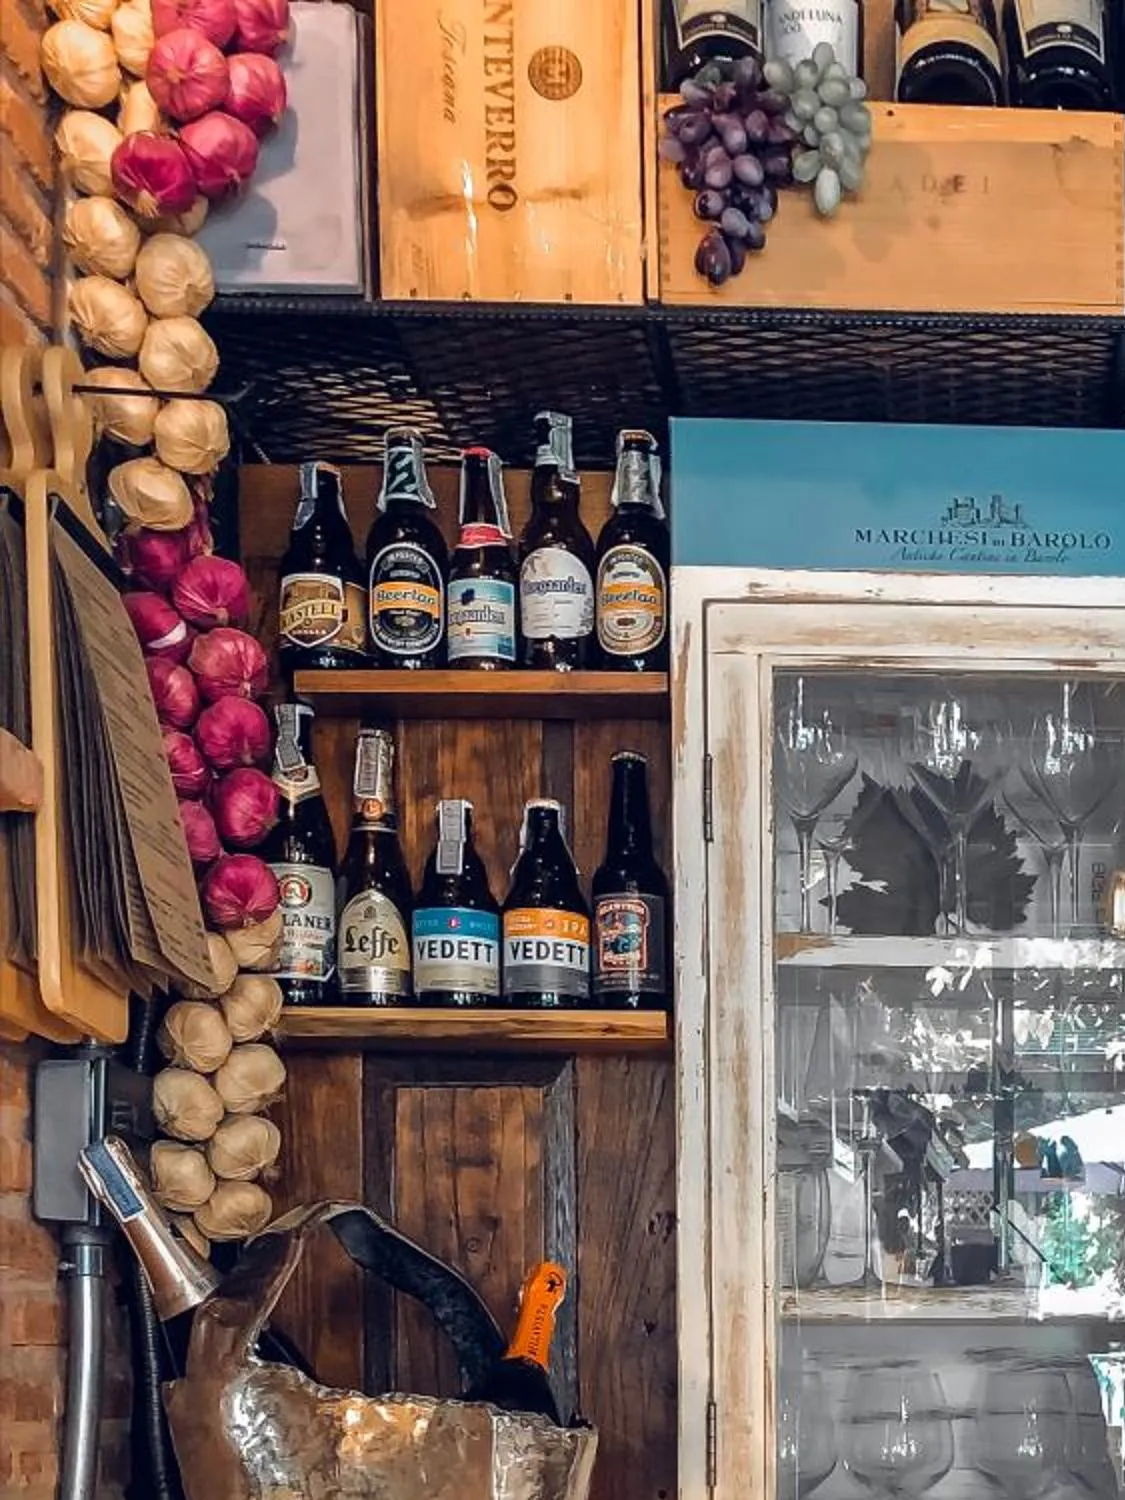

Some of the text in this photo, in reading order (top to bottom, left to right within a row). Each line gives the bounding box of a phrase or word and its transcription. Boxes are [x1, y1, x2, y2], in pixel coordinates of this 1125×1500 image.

[854, 529, 988, 548] MARCHESI
[1010, 531, 1113, 550] BAROLO
[344, 925, 400, 961] Leffe
[416, 939, 494, 964] VEDETT
[510, 940, 586, 965] VEDETT
